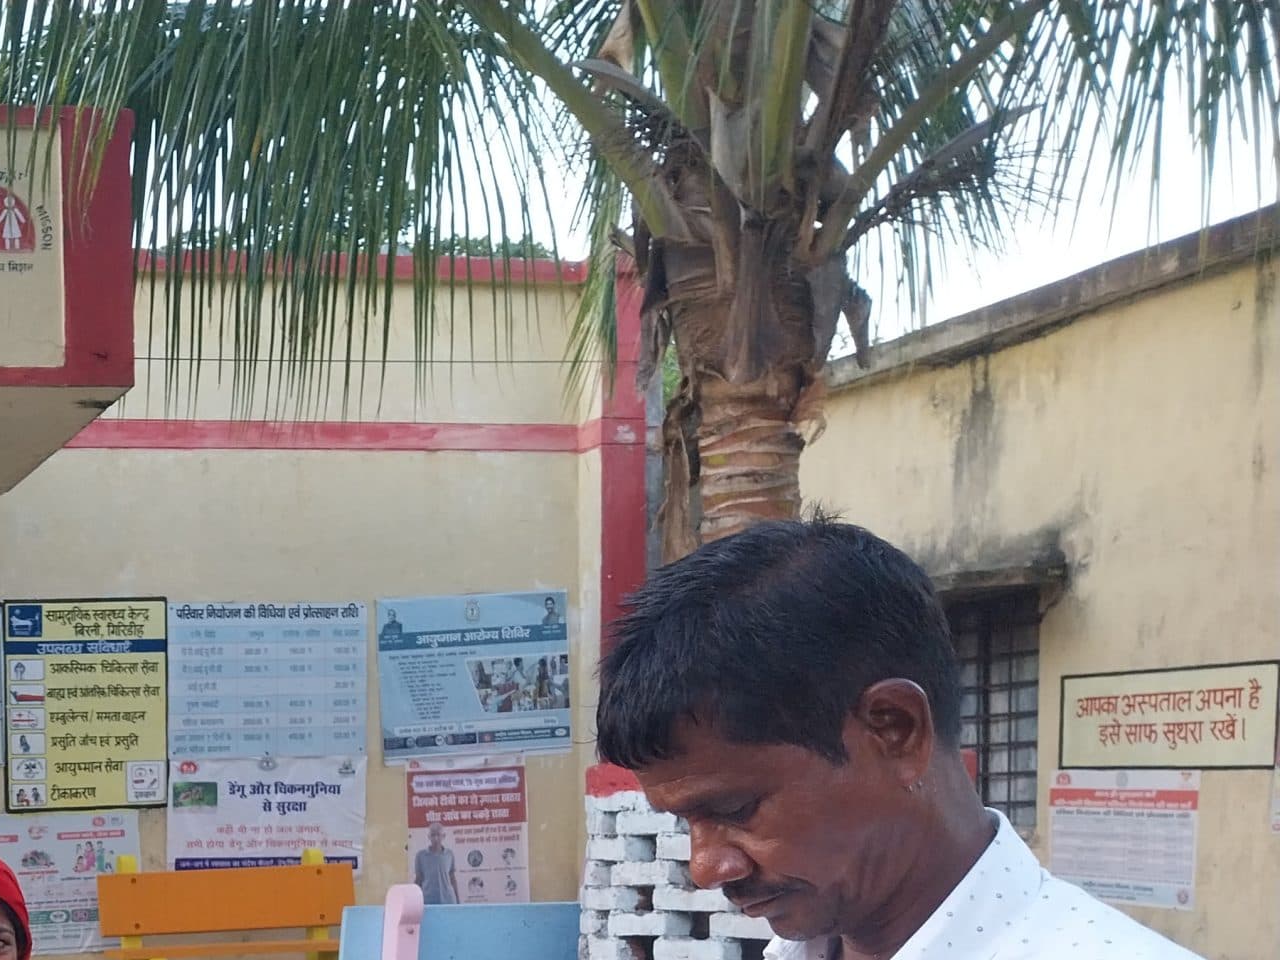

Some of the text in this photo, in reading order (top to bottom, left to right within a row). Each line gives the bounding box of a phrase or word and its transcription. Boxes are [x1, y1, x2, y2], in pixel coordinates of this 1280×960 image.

[45, 606, 91, 626] सामुदायिक
[176, 604, 204, 620] परिवार
[206, 604, 241, 620] नियोजन
[243, 603, 256, 619] की
[288, 603, 301, 619] एवं
[341, 602, 360, 619] राशि
[107, 621, 145, 638] गिरिडीह
[416, 632, 462, 649] आयुष्मान
[463, 629, 499, 644] आरोग्य
[501, 626, 531, 641] शिविर
[141, 659, 160, 675] सेवा
[143, 683, 160, 698] सेवा
[1076, 678, 1263, 719] आपका अस्पताल अपना है
[1098, 718, 1121, 746] इसे
[1124, 721, 1158, 745] साफ
[1162, 720, 1203, 750] सुथरा
[54, 757, 125, 777] आयुष्मान सेवा
[50, 784, 97, 801] टीकाकरण
[249, 781, 271, 795] और
[262, 800, 307, 815] से सुरक्षा
